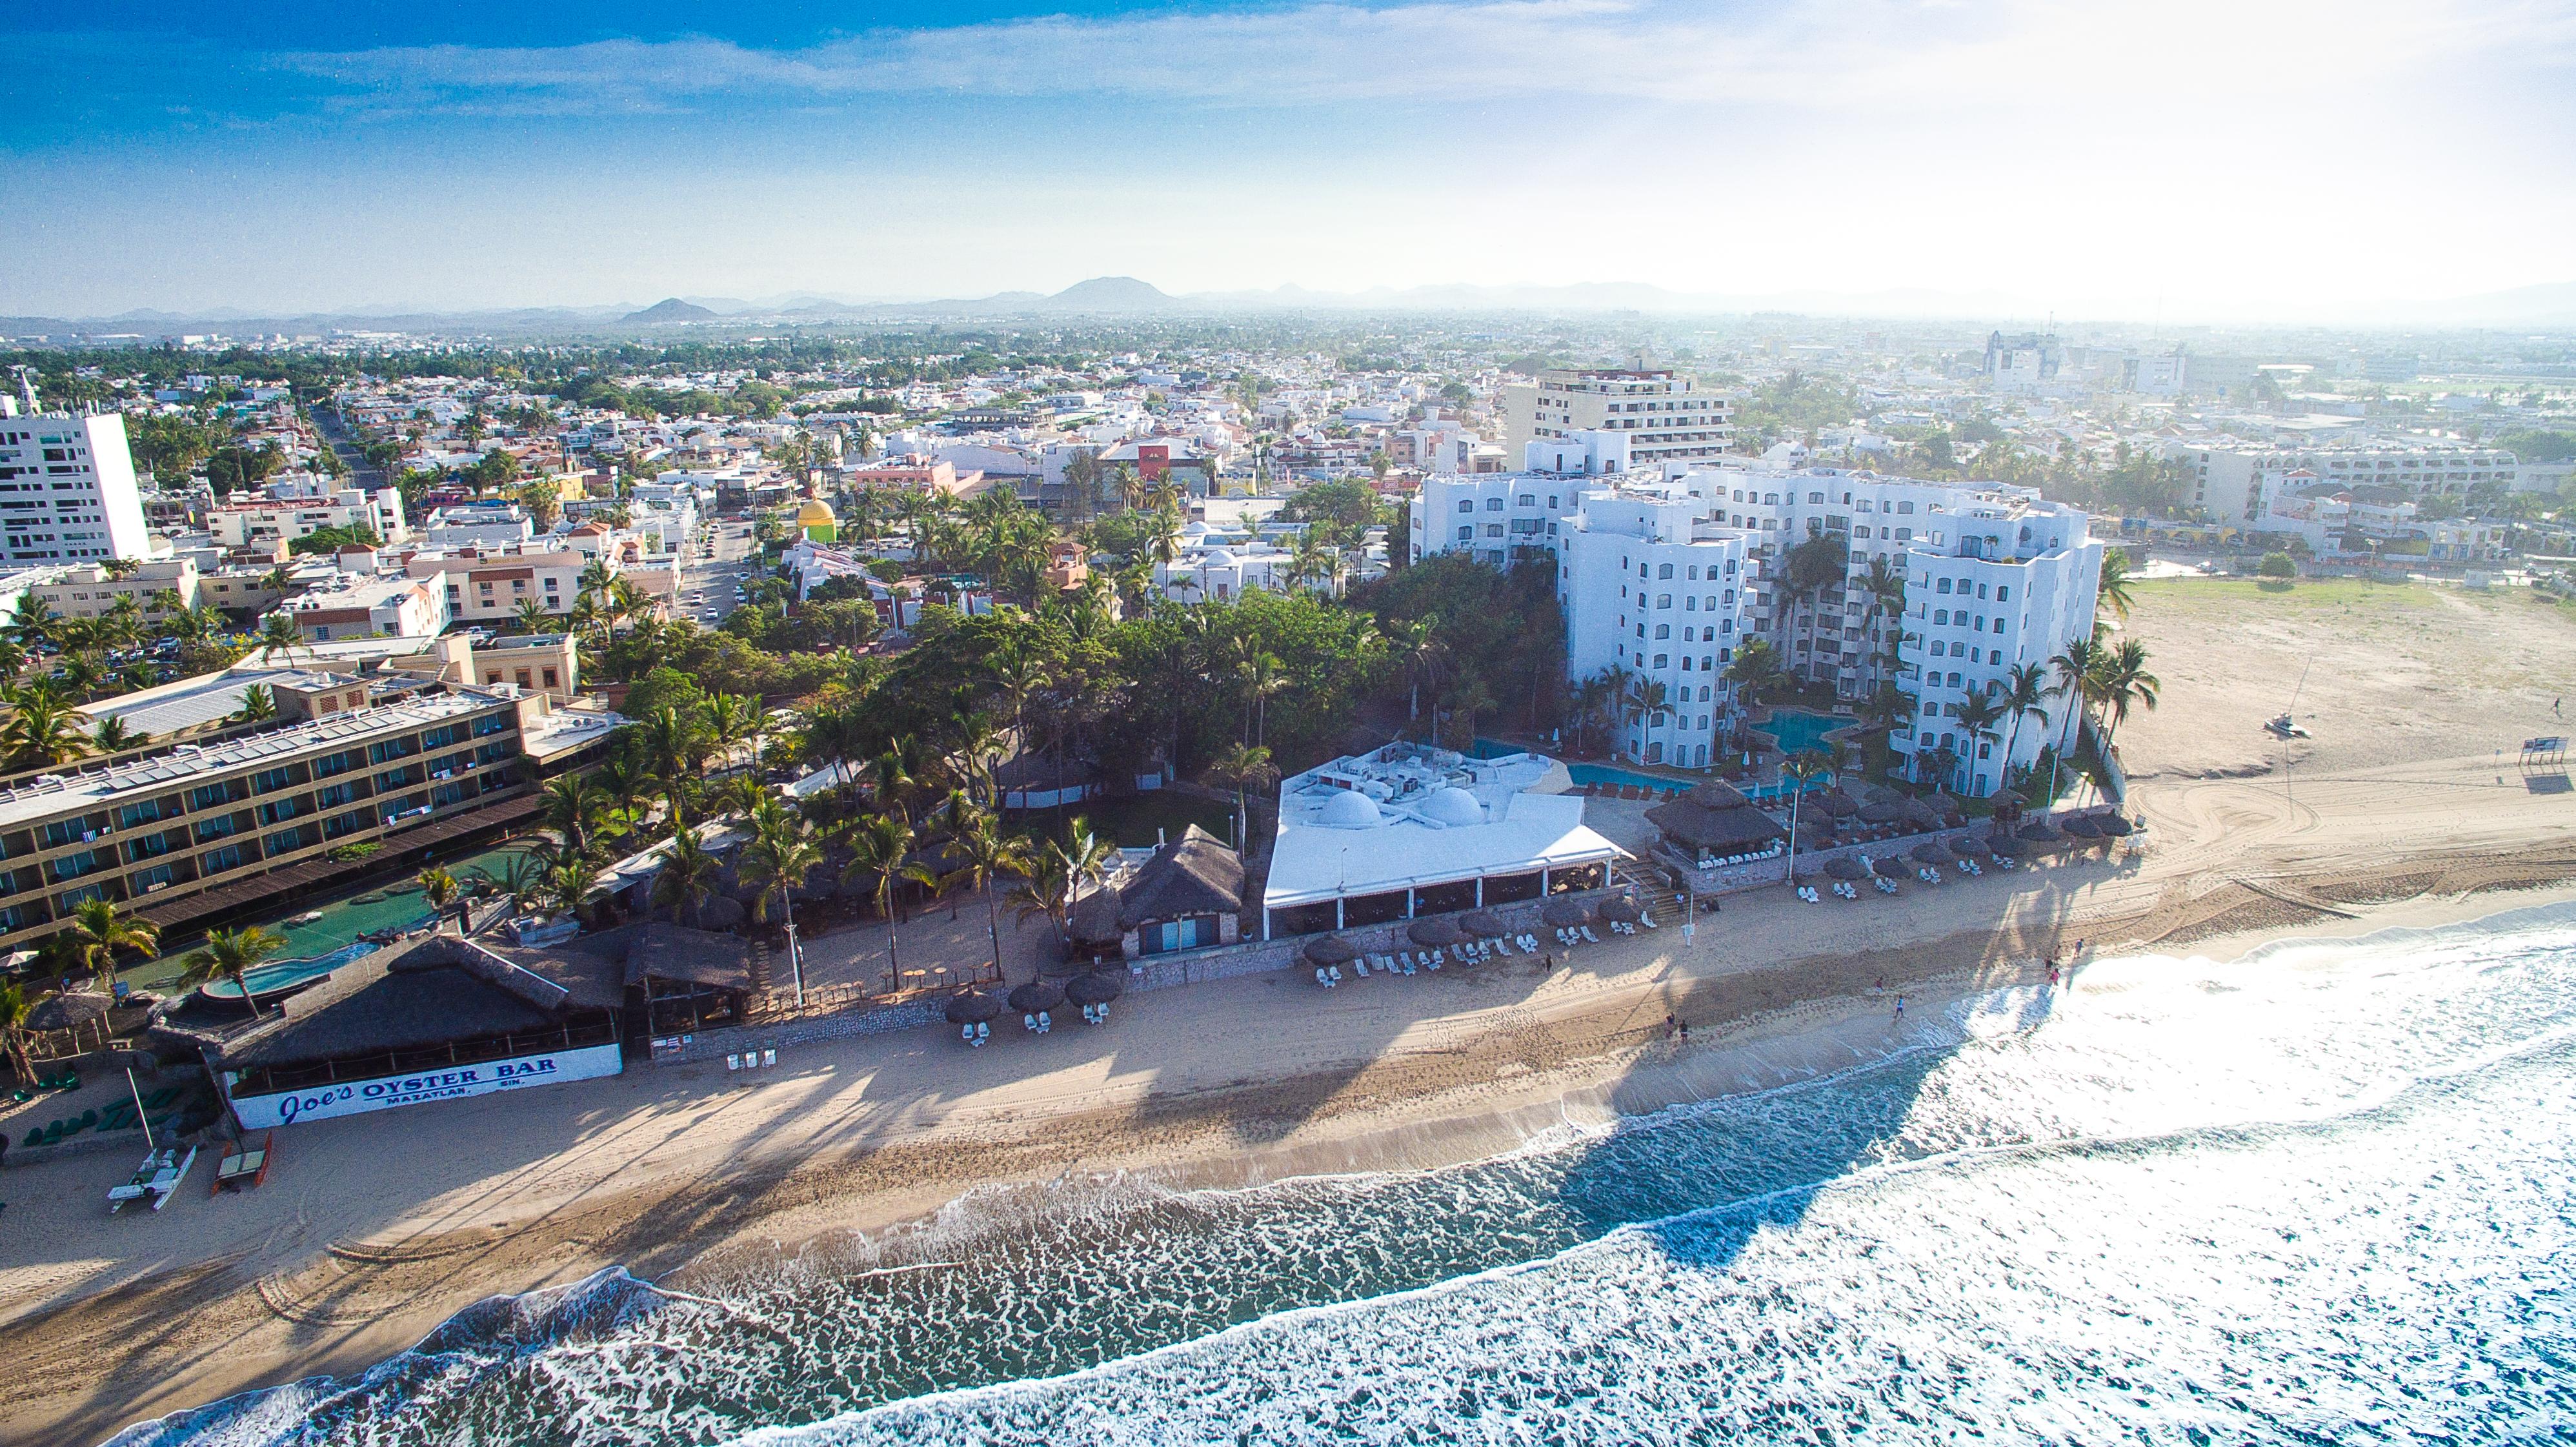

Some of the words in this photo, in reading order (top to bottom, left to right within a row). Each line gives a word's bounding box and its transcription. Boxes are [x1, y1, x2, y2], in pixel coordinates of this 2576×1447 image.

[279, 1086, 355, 1124] Joe's
[363, 1070, 480, 1097] OYSTER
[496, 1058, 557, 1077] BAR
